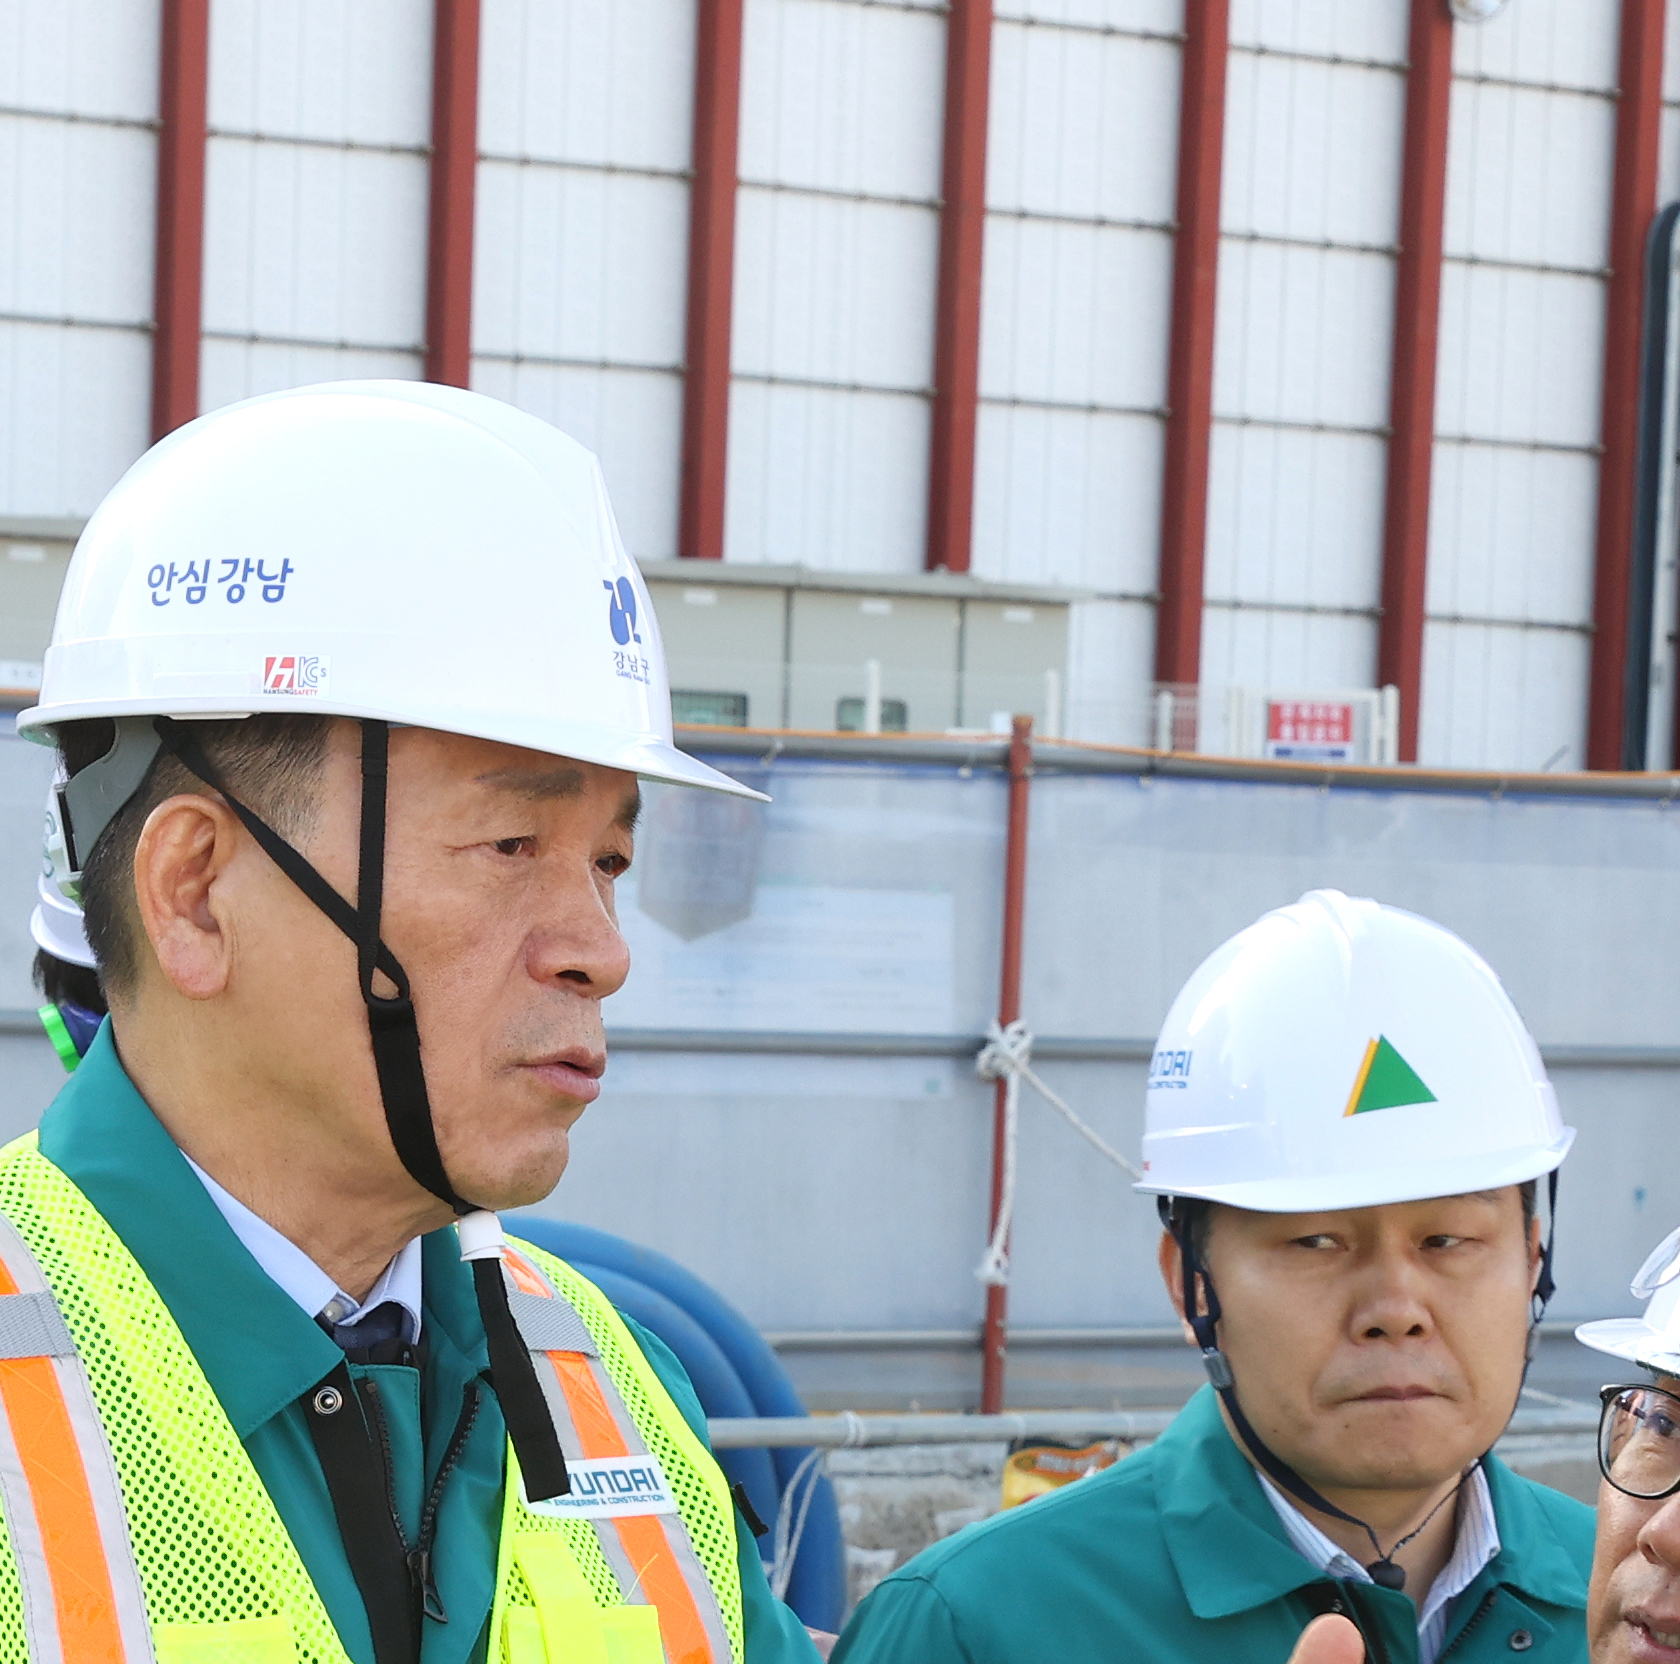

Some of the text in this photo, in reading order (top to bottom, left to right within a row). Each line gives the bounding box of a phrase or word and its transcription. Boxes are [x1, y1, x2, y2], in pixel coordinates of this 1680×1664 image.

[147, 558, 295, 607] 안심 강남
[613, 651, 650, 676] 강남구
[609, 1493, 665, 1505] CONSTRUCTION
